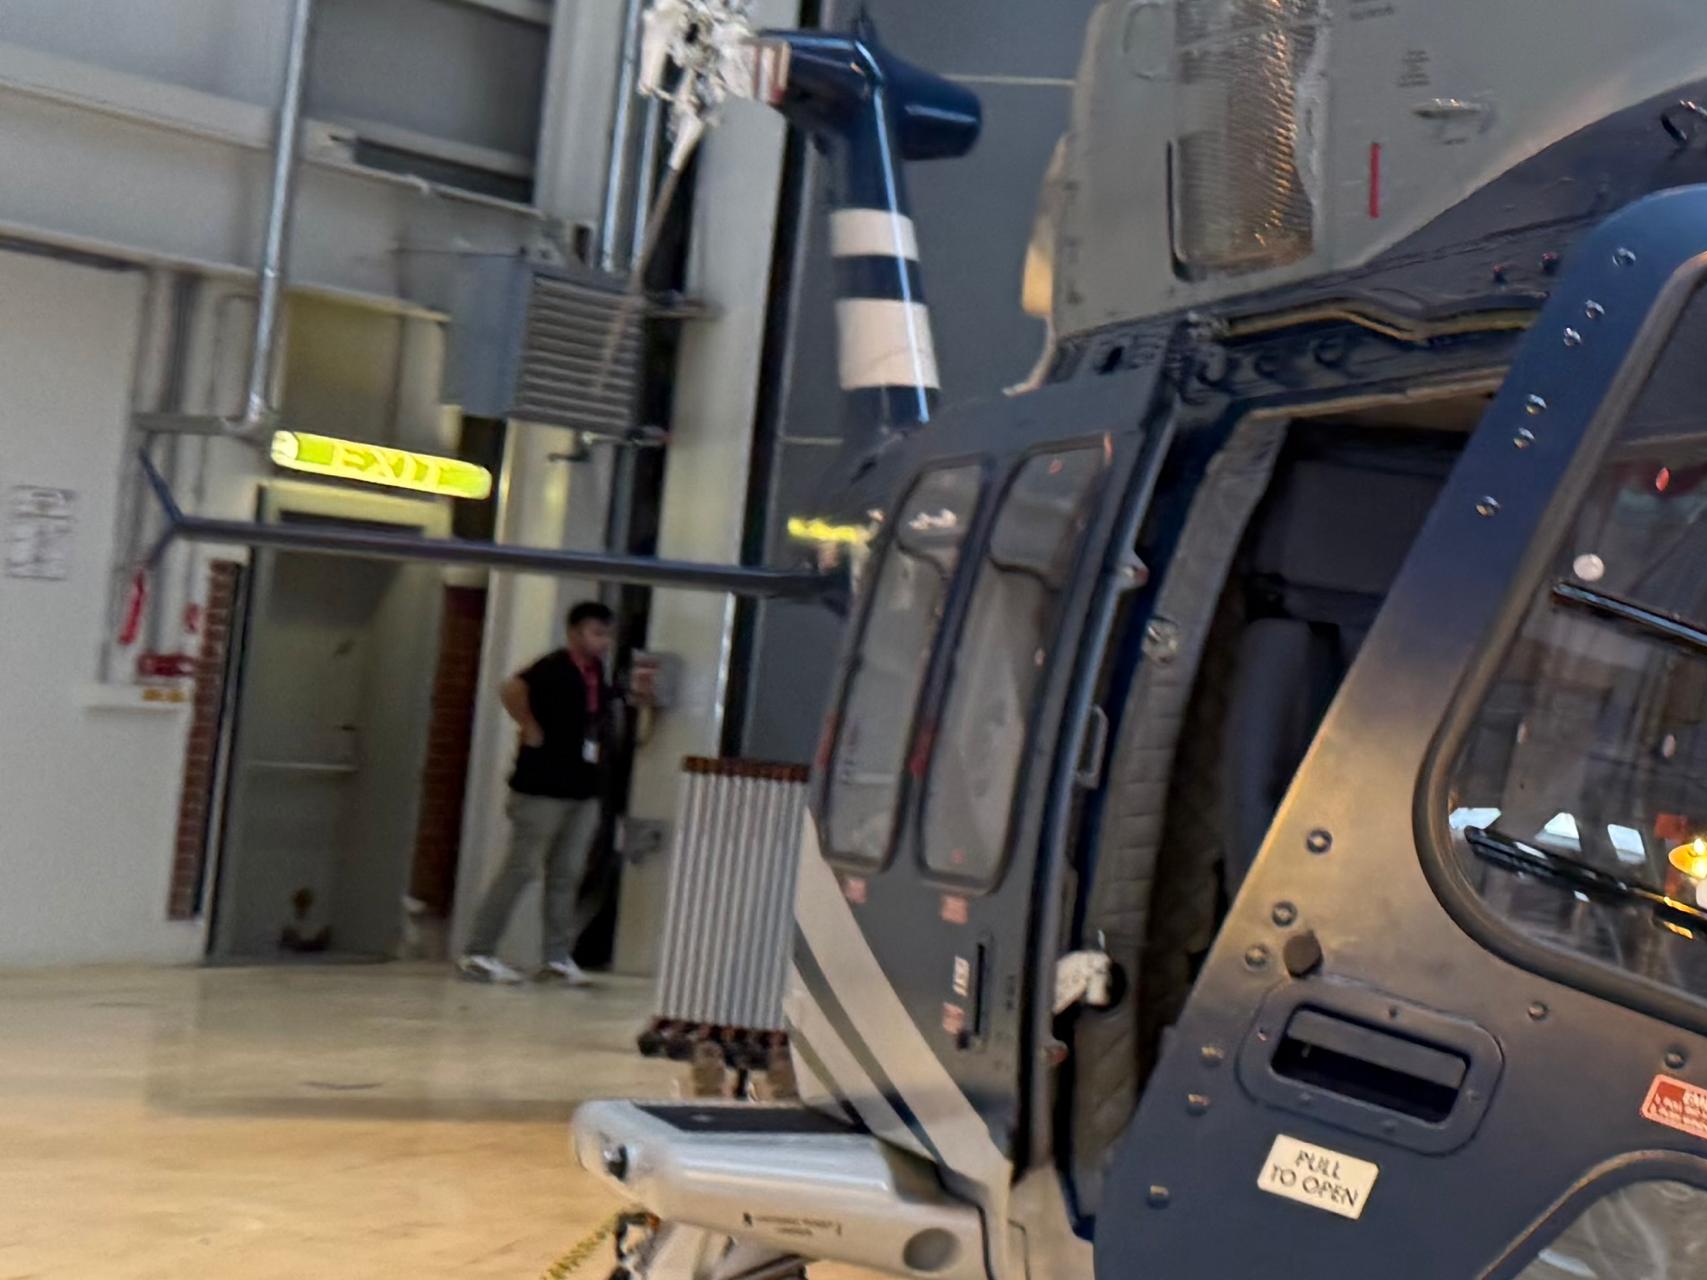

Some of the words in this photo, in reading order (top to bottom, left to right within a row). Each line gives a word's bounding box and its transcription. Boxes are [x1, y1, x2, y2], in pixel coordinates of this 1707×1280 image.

[330, 443, 446, 489] EXIT
[1270, 1163, 1297, 1188] TO
[1302, 1176, 1359, 1207] OPEN
[1295, 1149, 1341, 1180] PULL
